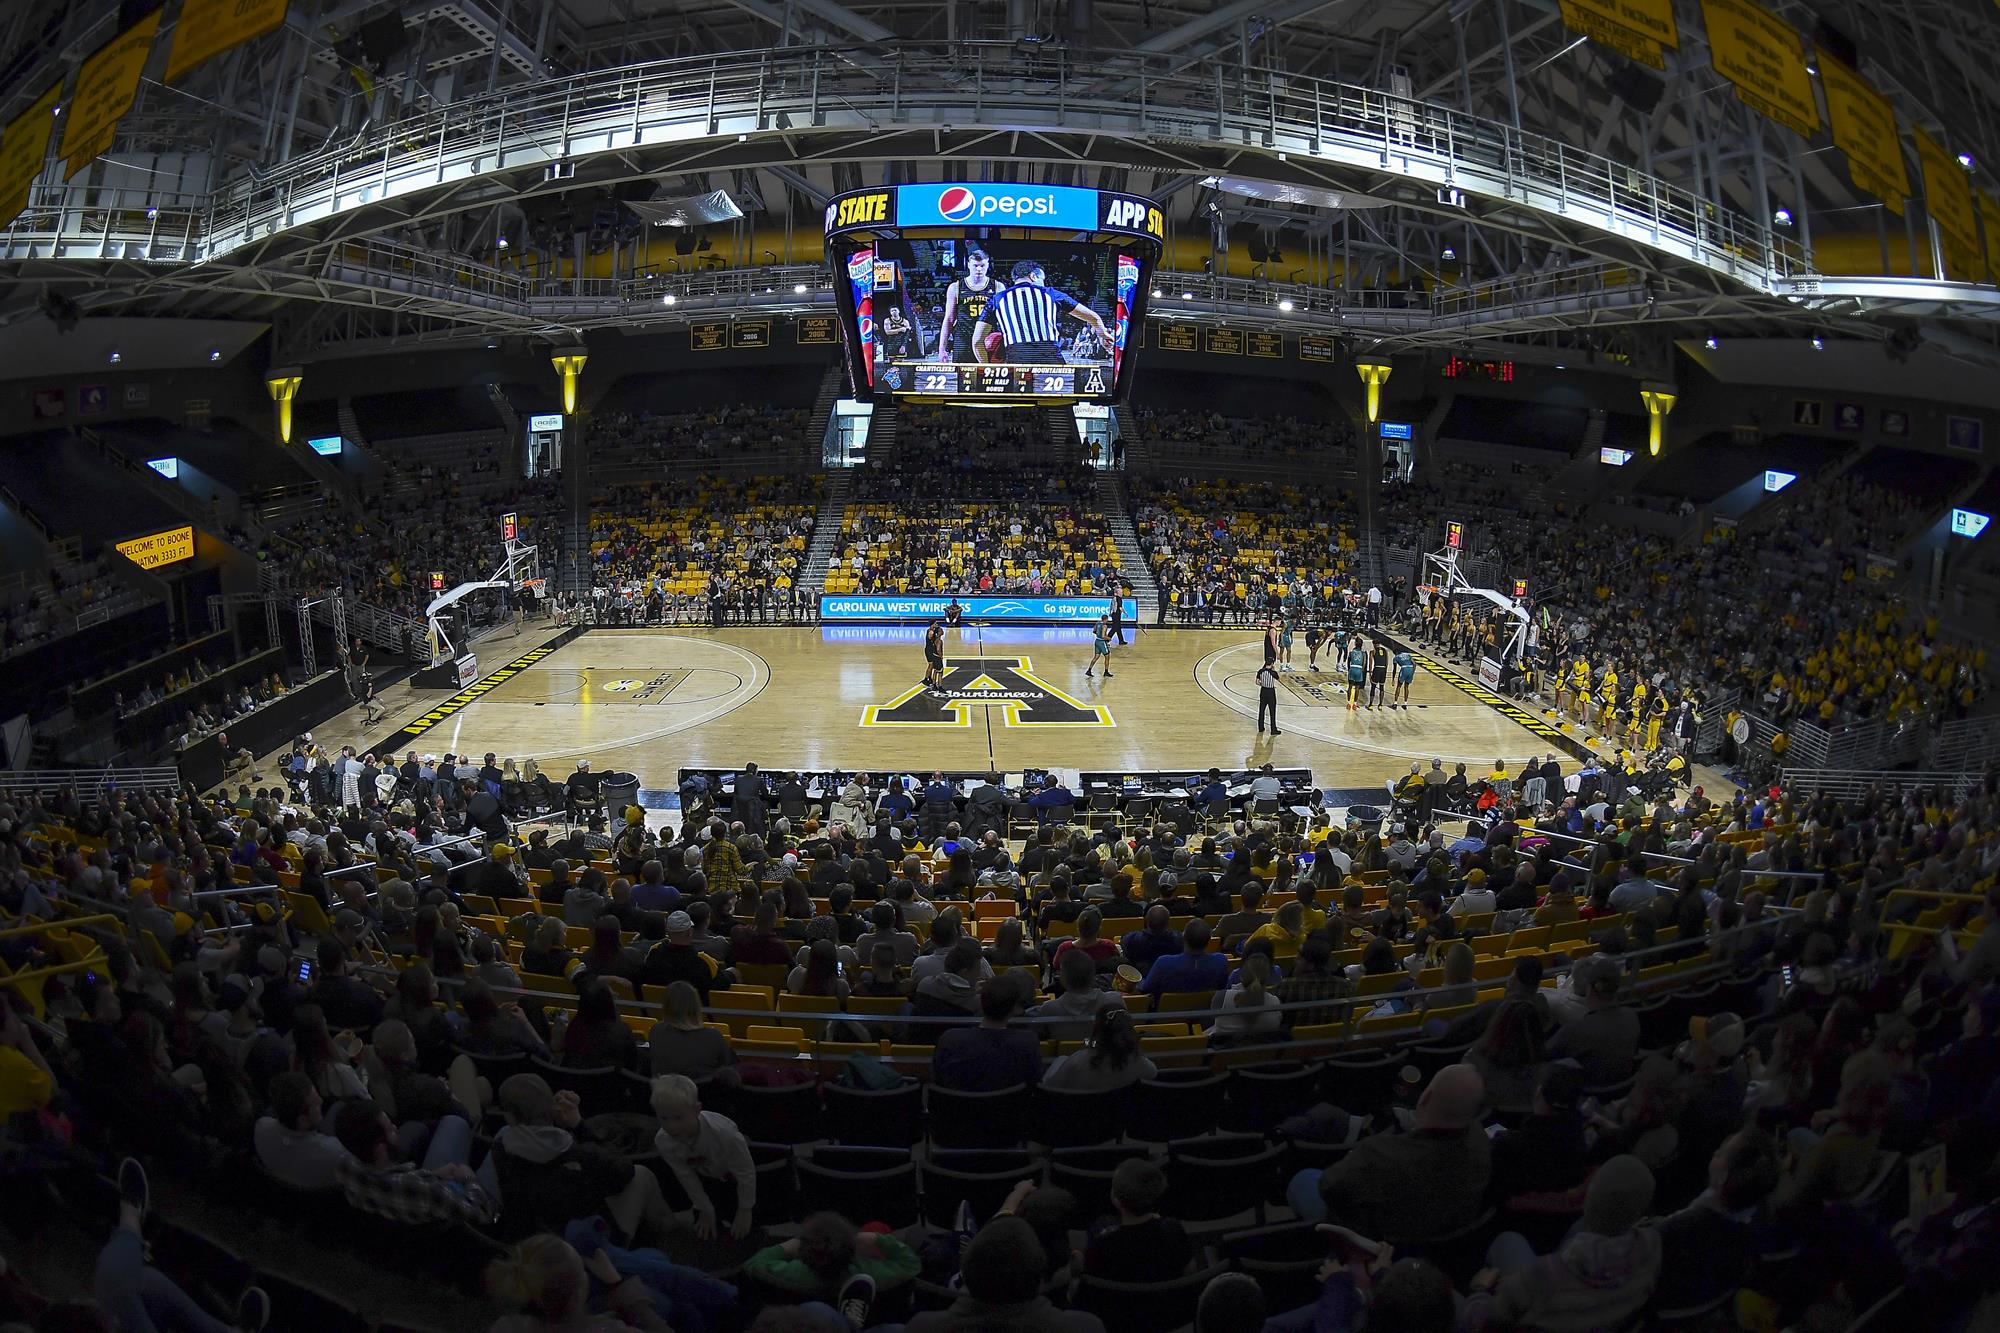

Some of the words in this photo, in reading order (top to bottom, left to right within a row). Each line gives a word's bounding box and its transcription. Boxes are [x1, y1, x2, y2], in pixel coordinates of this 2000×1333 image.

[838, 194, 889, 227] STATE
[1106, 199, 1146, 229] APP
[806, 319, 828, 327] NCAA
[984, 366, 1009, 378] 9:10
[925, 375, 947, 390] 22
[994, 378, 1010, 386] HALF
[1043, 377, 1064, 392] 20
[157, 537, 165, 548] TO
[167, 531, 190, 545] BOONE
[161, 549, 177, 562] 3333
[829, 602, 884, 612] CAROLINA
[884, 602, 918, 612] WEST
[919, 602, 971, 612] WIRESS
[1043, 603, 1056, 614] Go
[1058, 604, 1078, 617] stay
[1080, 603, 1111, 614] connec
[403, 670, 518, 735] APPALACHIAN
[510, 648, 554, 668] STATE
[1497, 707, 1562, 736] STATE
